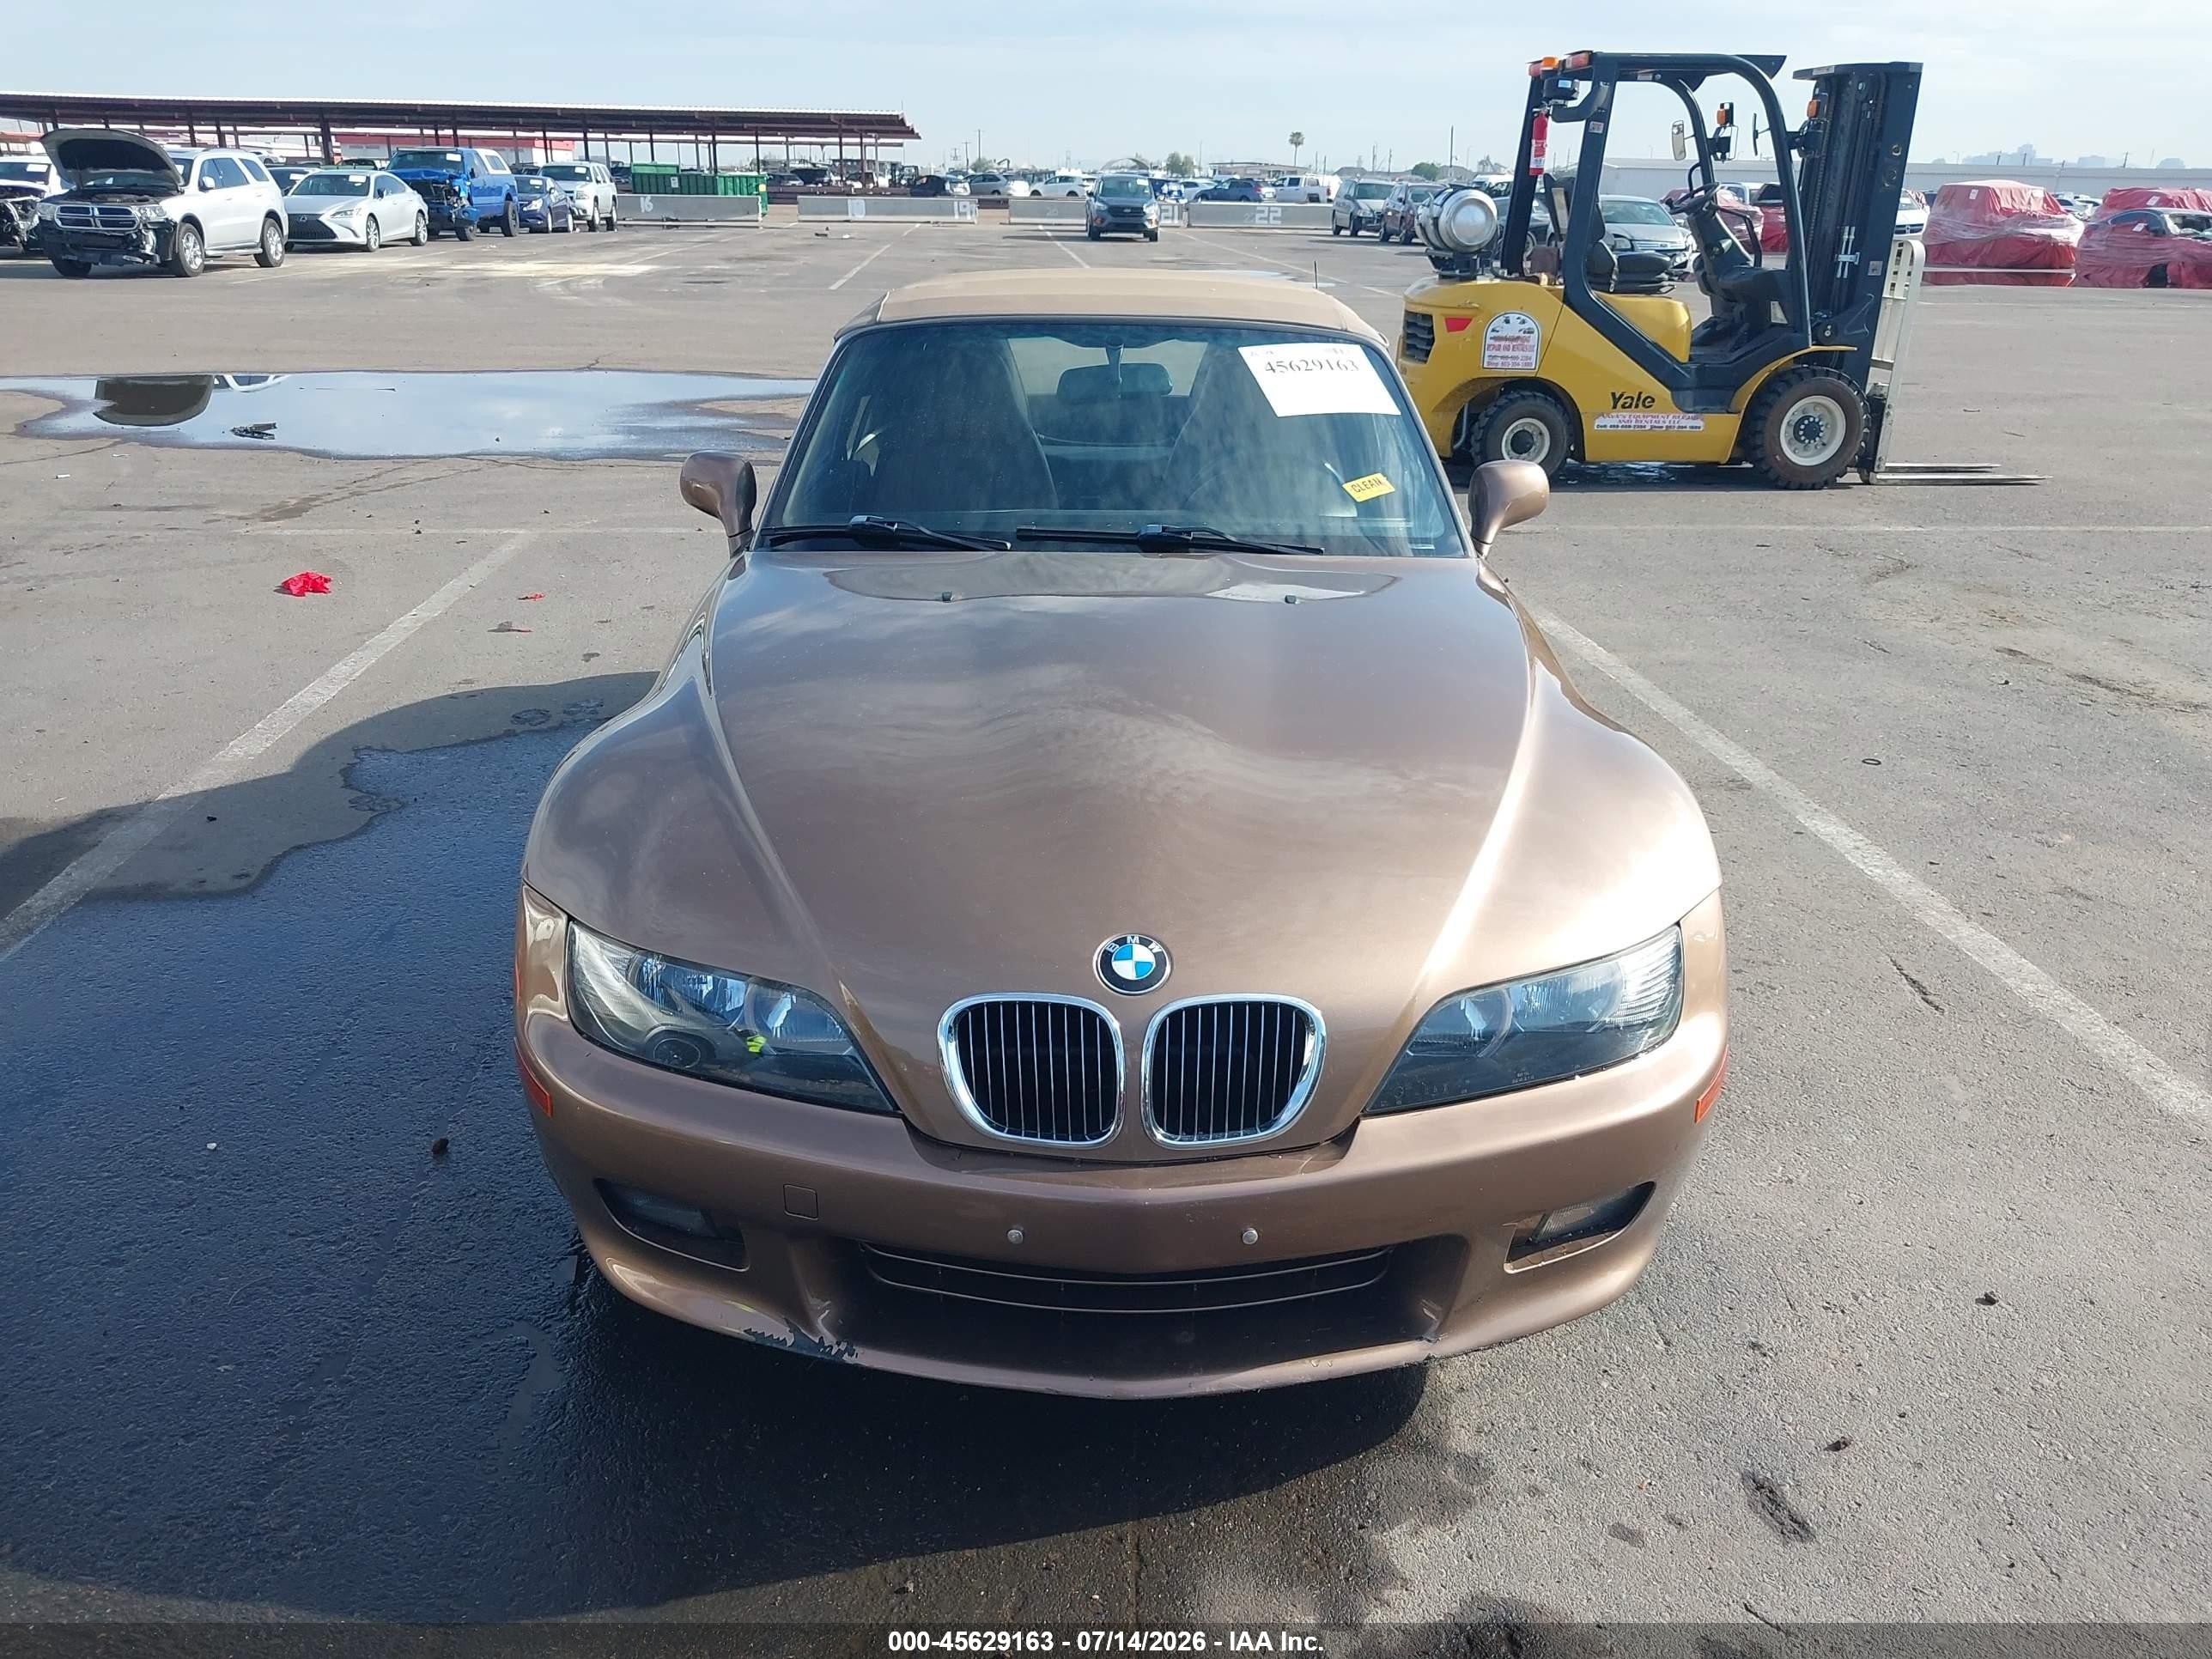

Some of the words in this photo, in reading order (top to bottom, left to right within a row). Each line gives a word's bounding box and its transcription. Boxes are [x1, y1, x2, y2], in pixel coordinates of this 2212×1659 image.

[640, 197, 653, 213] 16
[1255, 206, 1282, 224] 22
[1265, 359, 1359, 374] 45629163
[1610, 392, 1656, 410] Yale
[1351, 477, 1382, 493] CLEAN
[1105, 935, 1163, 953] BMW
